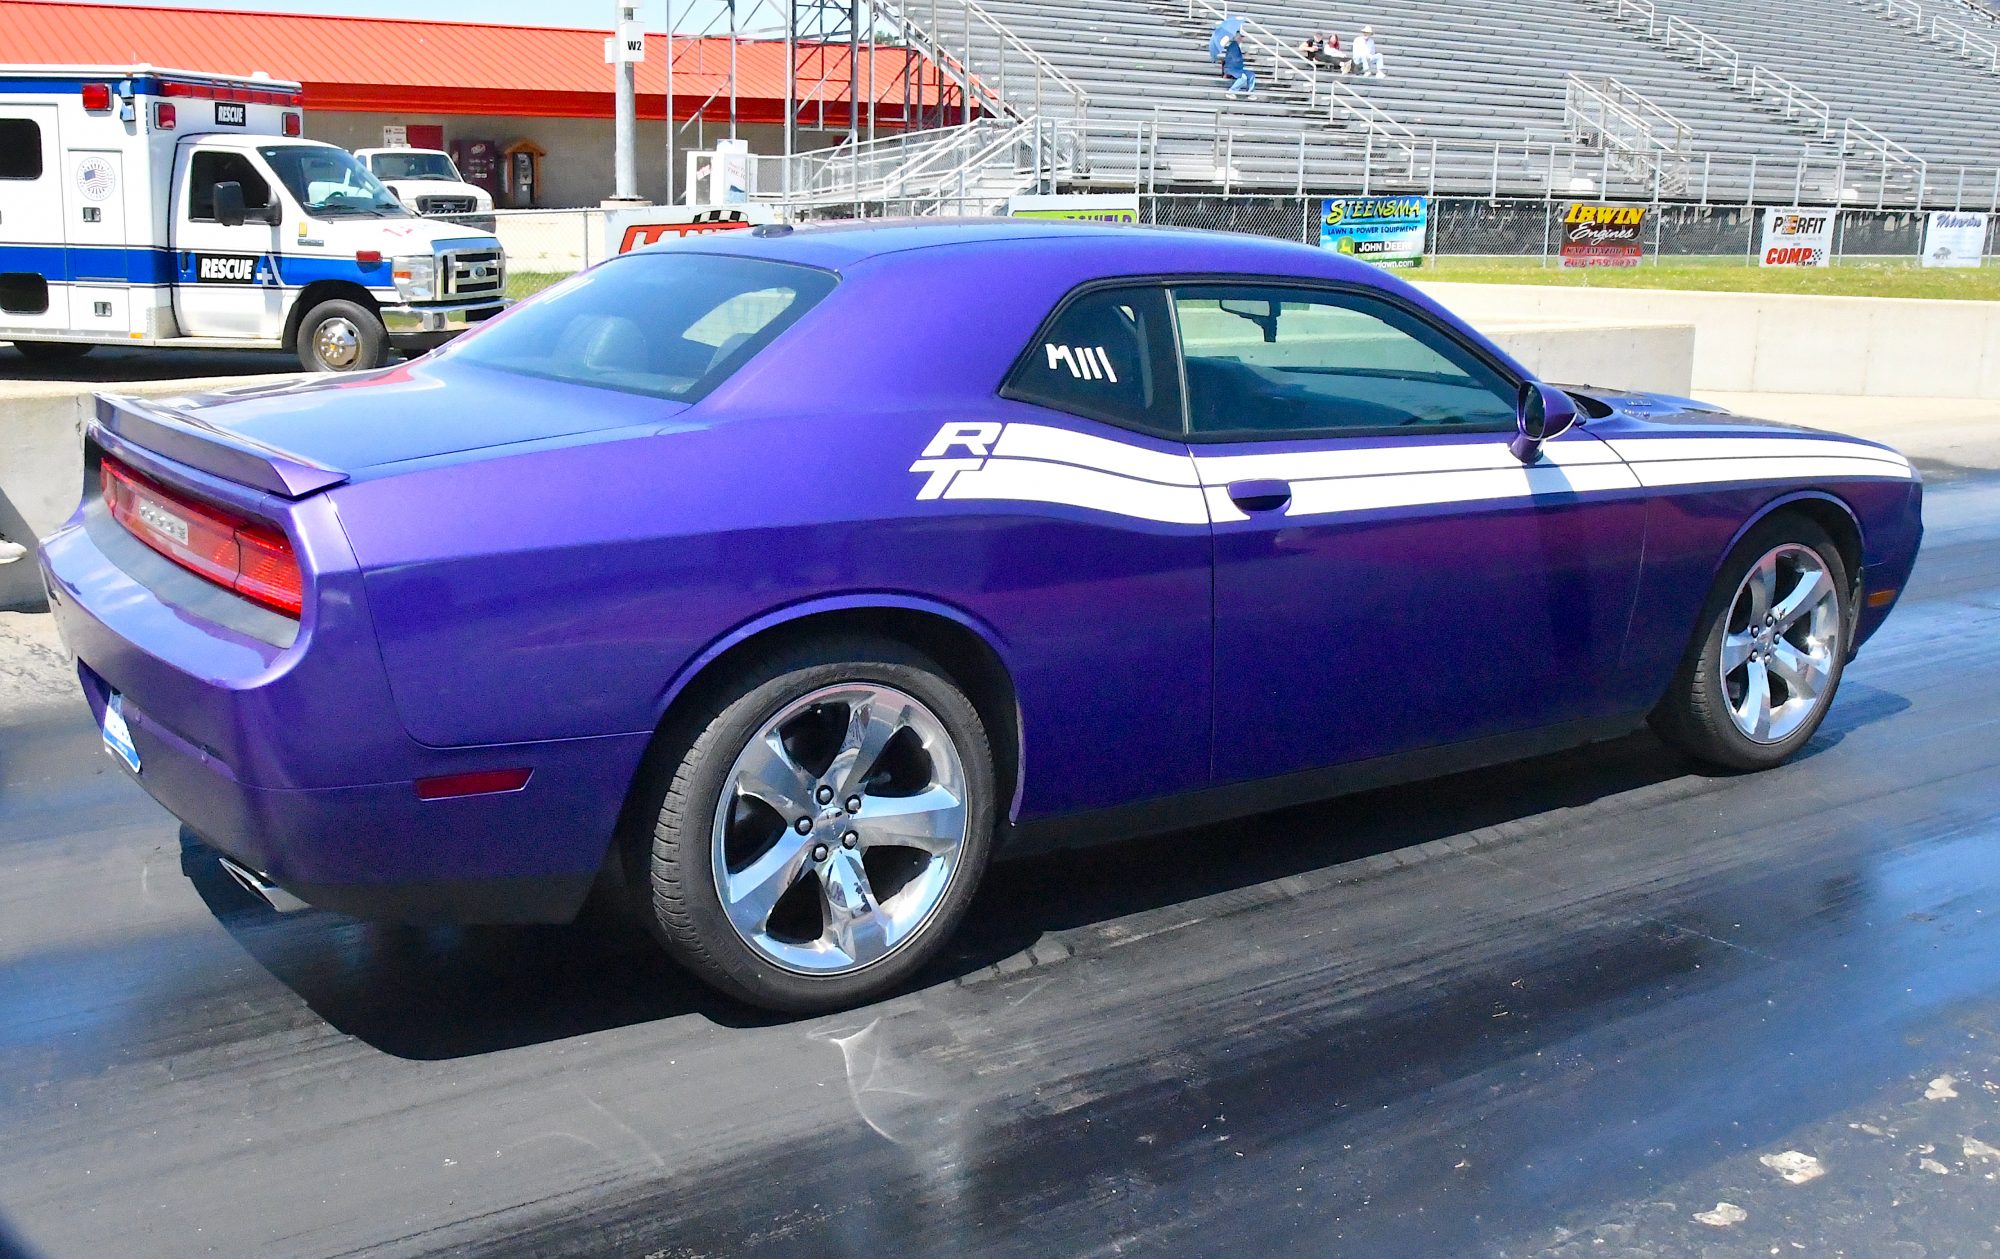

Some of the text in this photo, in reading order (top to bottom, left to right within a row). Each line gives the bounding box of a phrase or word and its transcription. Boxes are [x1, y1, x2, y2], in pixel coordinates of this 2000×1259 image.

[627, 40, 642, 51] W2
[217, 105, 243, 123] RESCUE
[1326, 199, 1421, 225] STEENSMA
[1564, 203, 1646, 225] IRWIN
[1328, 228, 1347, 236] LAWN
[1381, 225, 1418, 234] EQUIPMENT
[1569, 221, 1634, 246] Engines
[1772, 215, 1827, 235] PERFIT
[1359, 242, 1382, 253] JOHN
[1765, 248, 1813, 265] COMP
[200, 257, 254, 280] RESCUE
